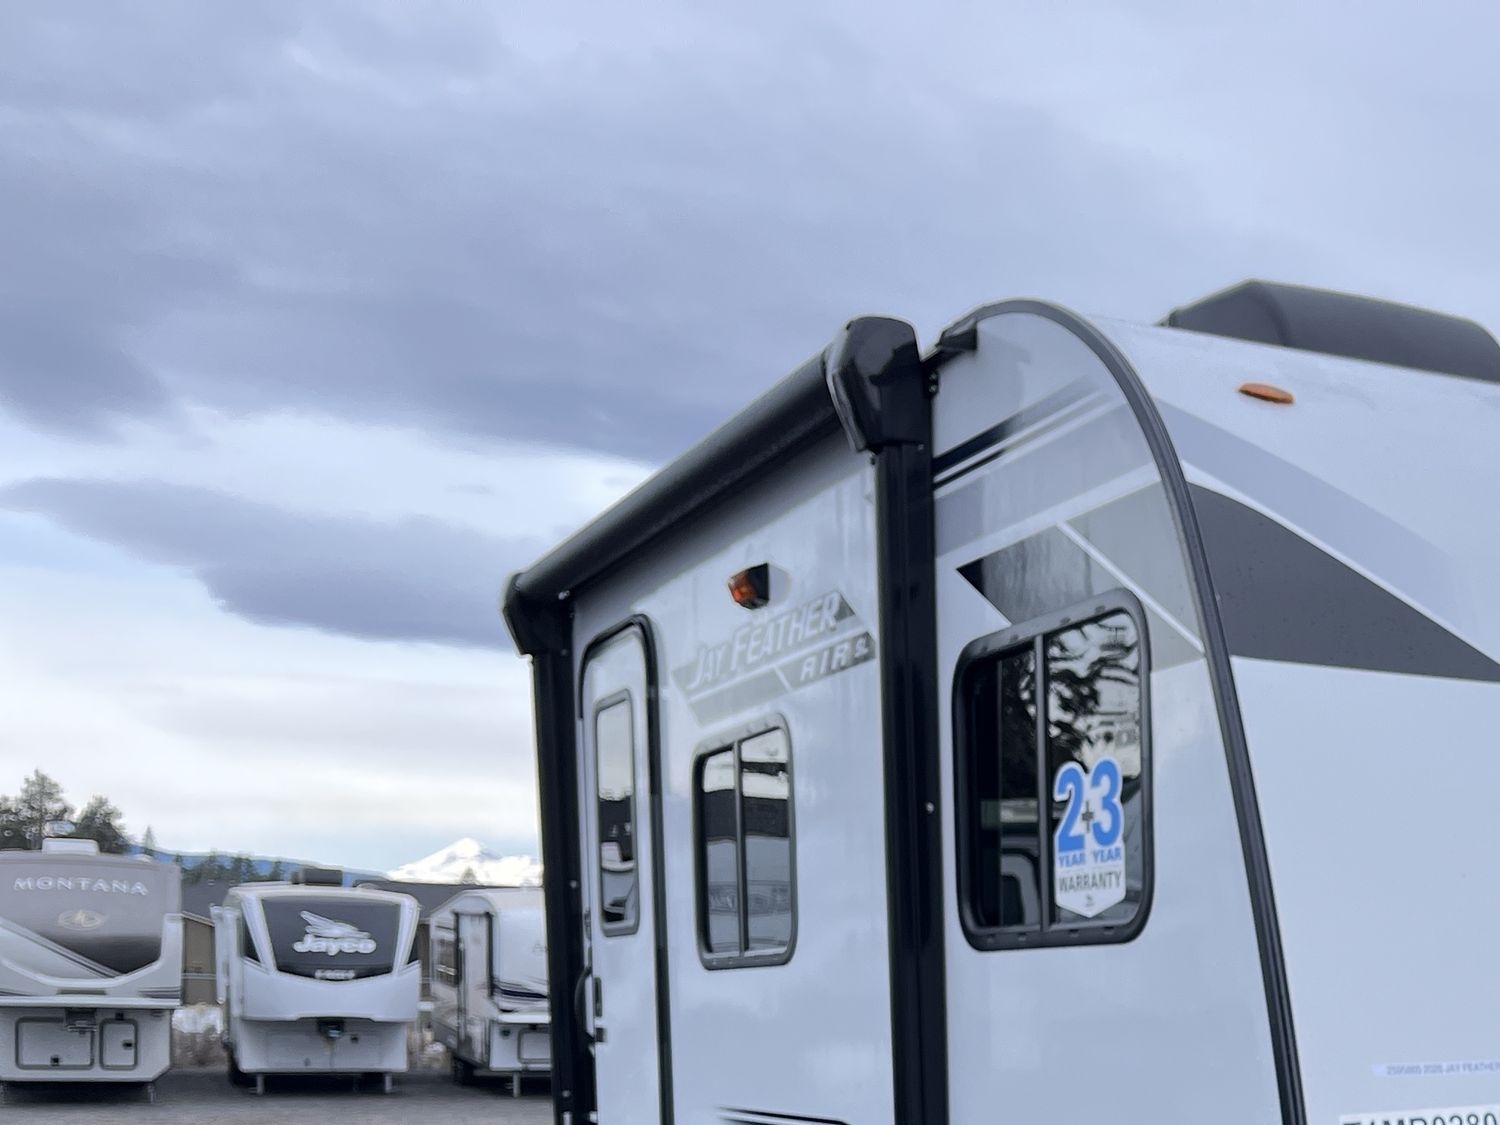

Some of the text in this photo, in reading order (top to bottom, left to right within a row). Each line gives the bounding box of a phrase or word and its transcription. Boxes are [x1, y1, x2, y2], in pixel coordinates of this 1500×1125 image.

[730, 592, 841, 671] FEATHER
[800, 643, 849, 681] AIR
[1059, 847, 1121, 868] YEAR YEAR
[13, 876, 148, 896] MONTANA
[1059, 871, 1122, 892] WARRANTY
[293, 933, 377, 956] Jayco
